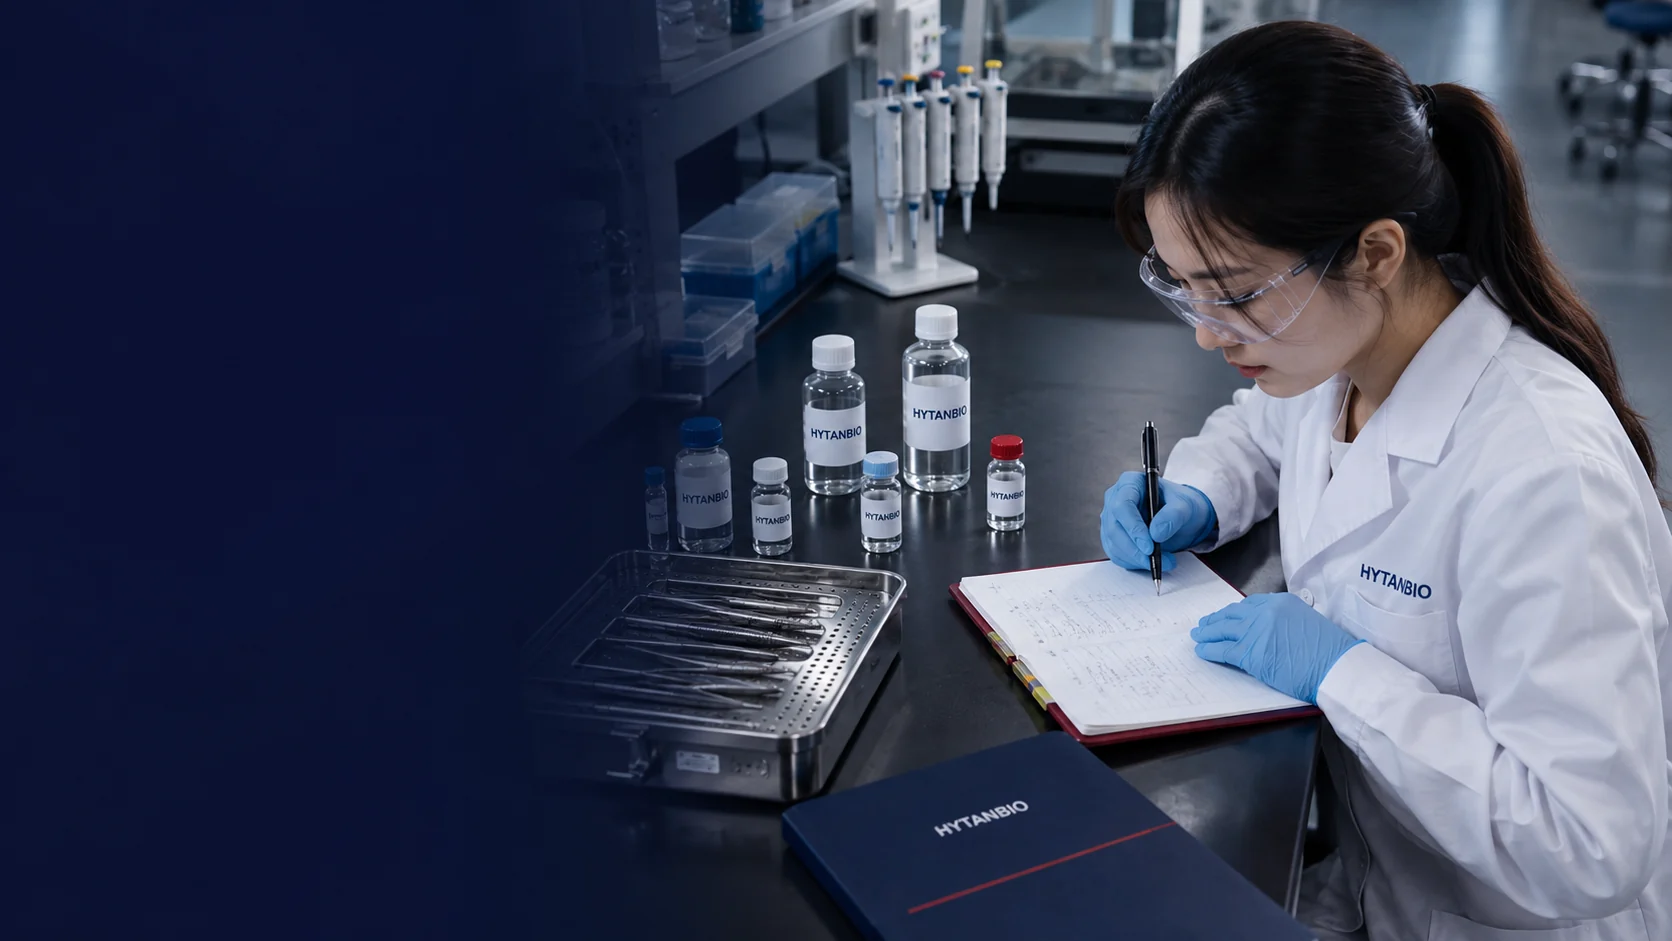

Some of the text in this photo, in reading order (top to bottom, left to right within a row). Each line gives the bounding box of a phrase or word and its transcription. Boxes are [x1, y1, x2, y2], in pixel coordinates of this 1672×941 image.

[913, 404, 968, 421] HYTANBIO
[811, 425, 862, 441] HYTANBIO
[682, 489, 729, 505] HYTANBIO
[990, 490, 1024, 501] HYTANBIO
[755, 513, 791, 525] HYTANBIO
[865, 510, 900, 521] HYTANBIO
[1360, 563, 1432, 599] HYTANBIO
[934, 800, 1029, 837] HYTANBIO
